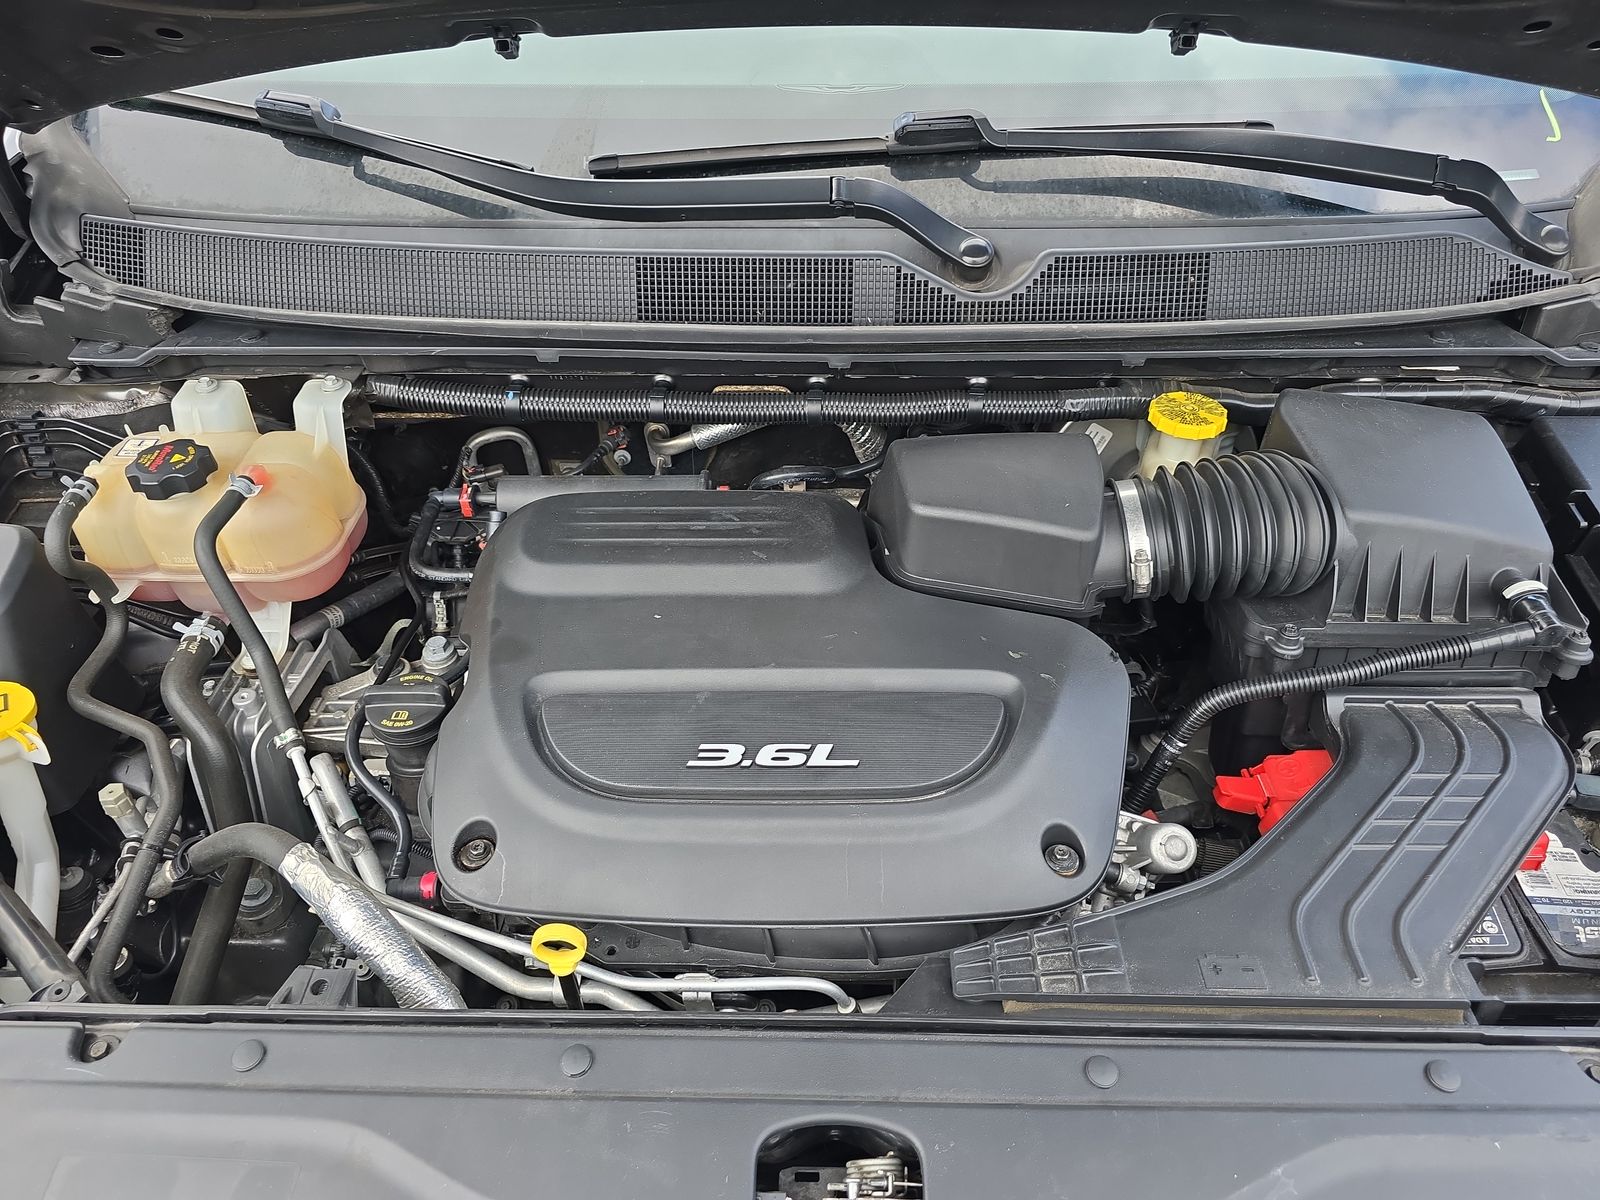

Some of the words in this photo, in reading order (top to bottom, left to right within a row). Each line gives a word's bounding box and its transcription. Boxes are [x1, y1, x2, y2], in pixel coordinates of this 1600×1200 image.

[399, 674, 424, 682] ENGINE
[424, 675, 434, 683] OIL
[380, 719, 394, 727] SAE
[685, 743, 861, 767] 3.6L
